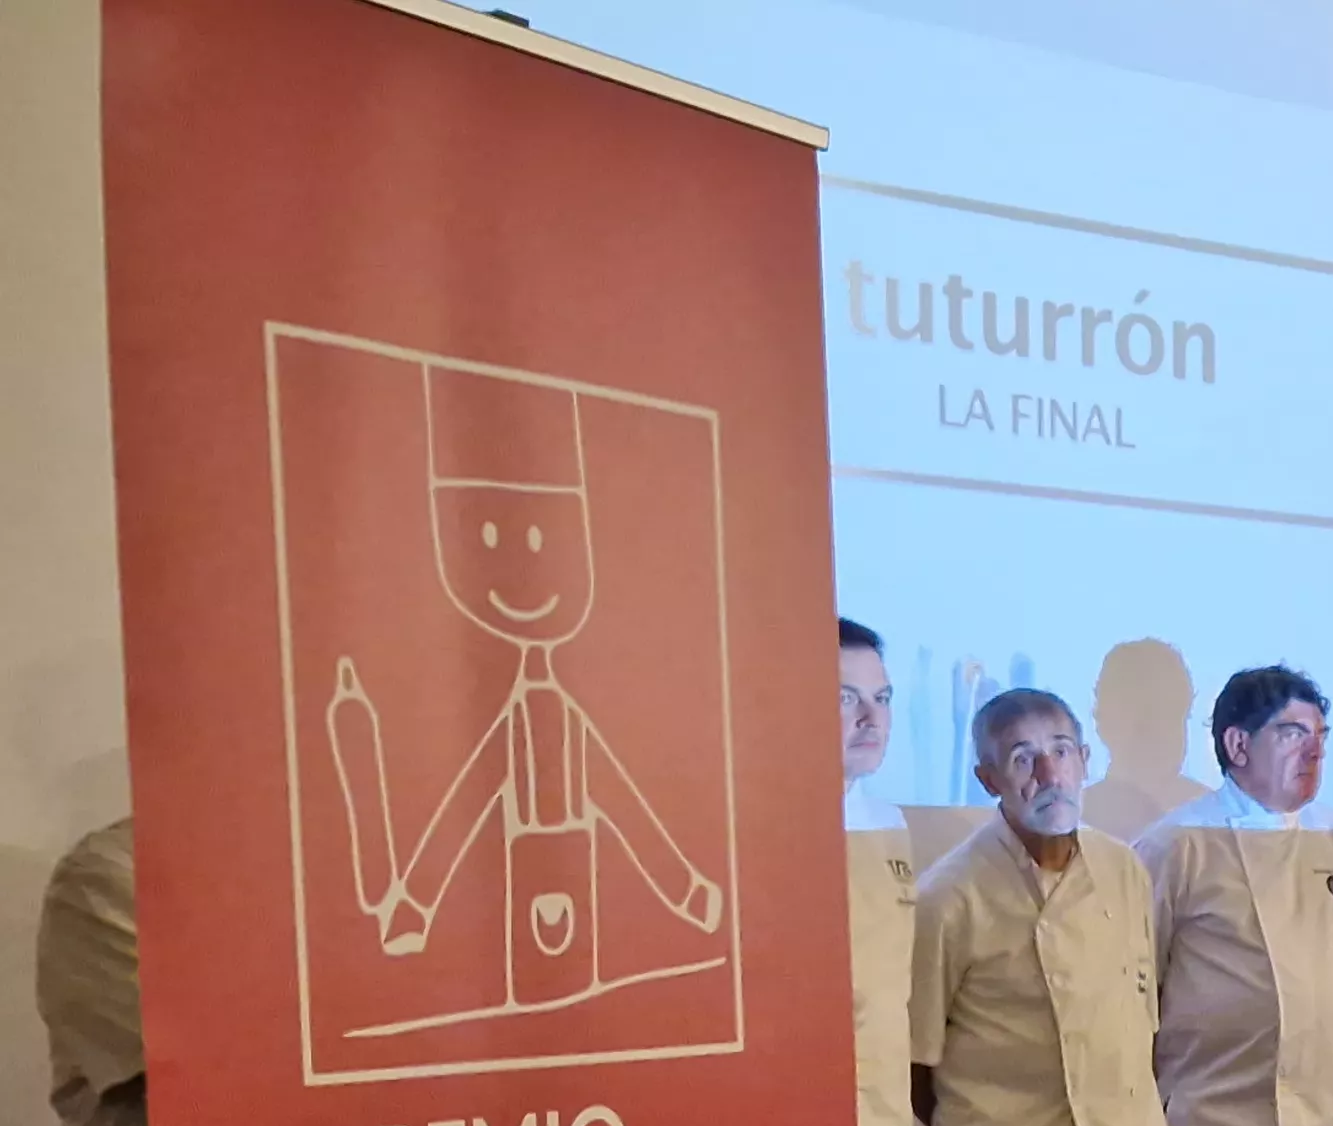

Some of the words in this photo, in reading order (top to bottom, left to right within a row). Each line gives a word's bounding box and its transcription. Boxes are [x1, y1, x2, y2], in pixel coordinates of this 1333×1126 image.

[843, 259, 1218, 386] tuturrón
[938, 383, 995, 433] LA
[1010, 393, 1137, 450] FINAL
